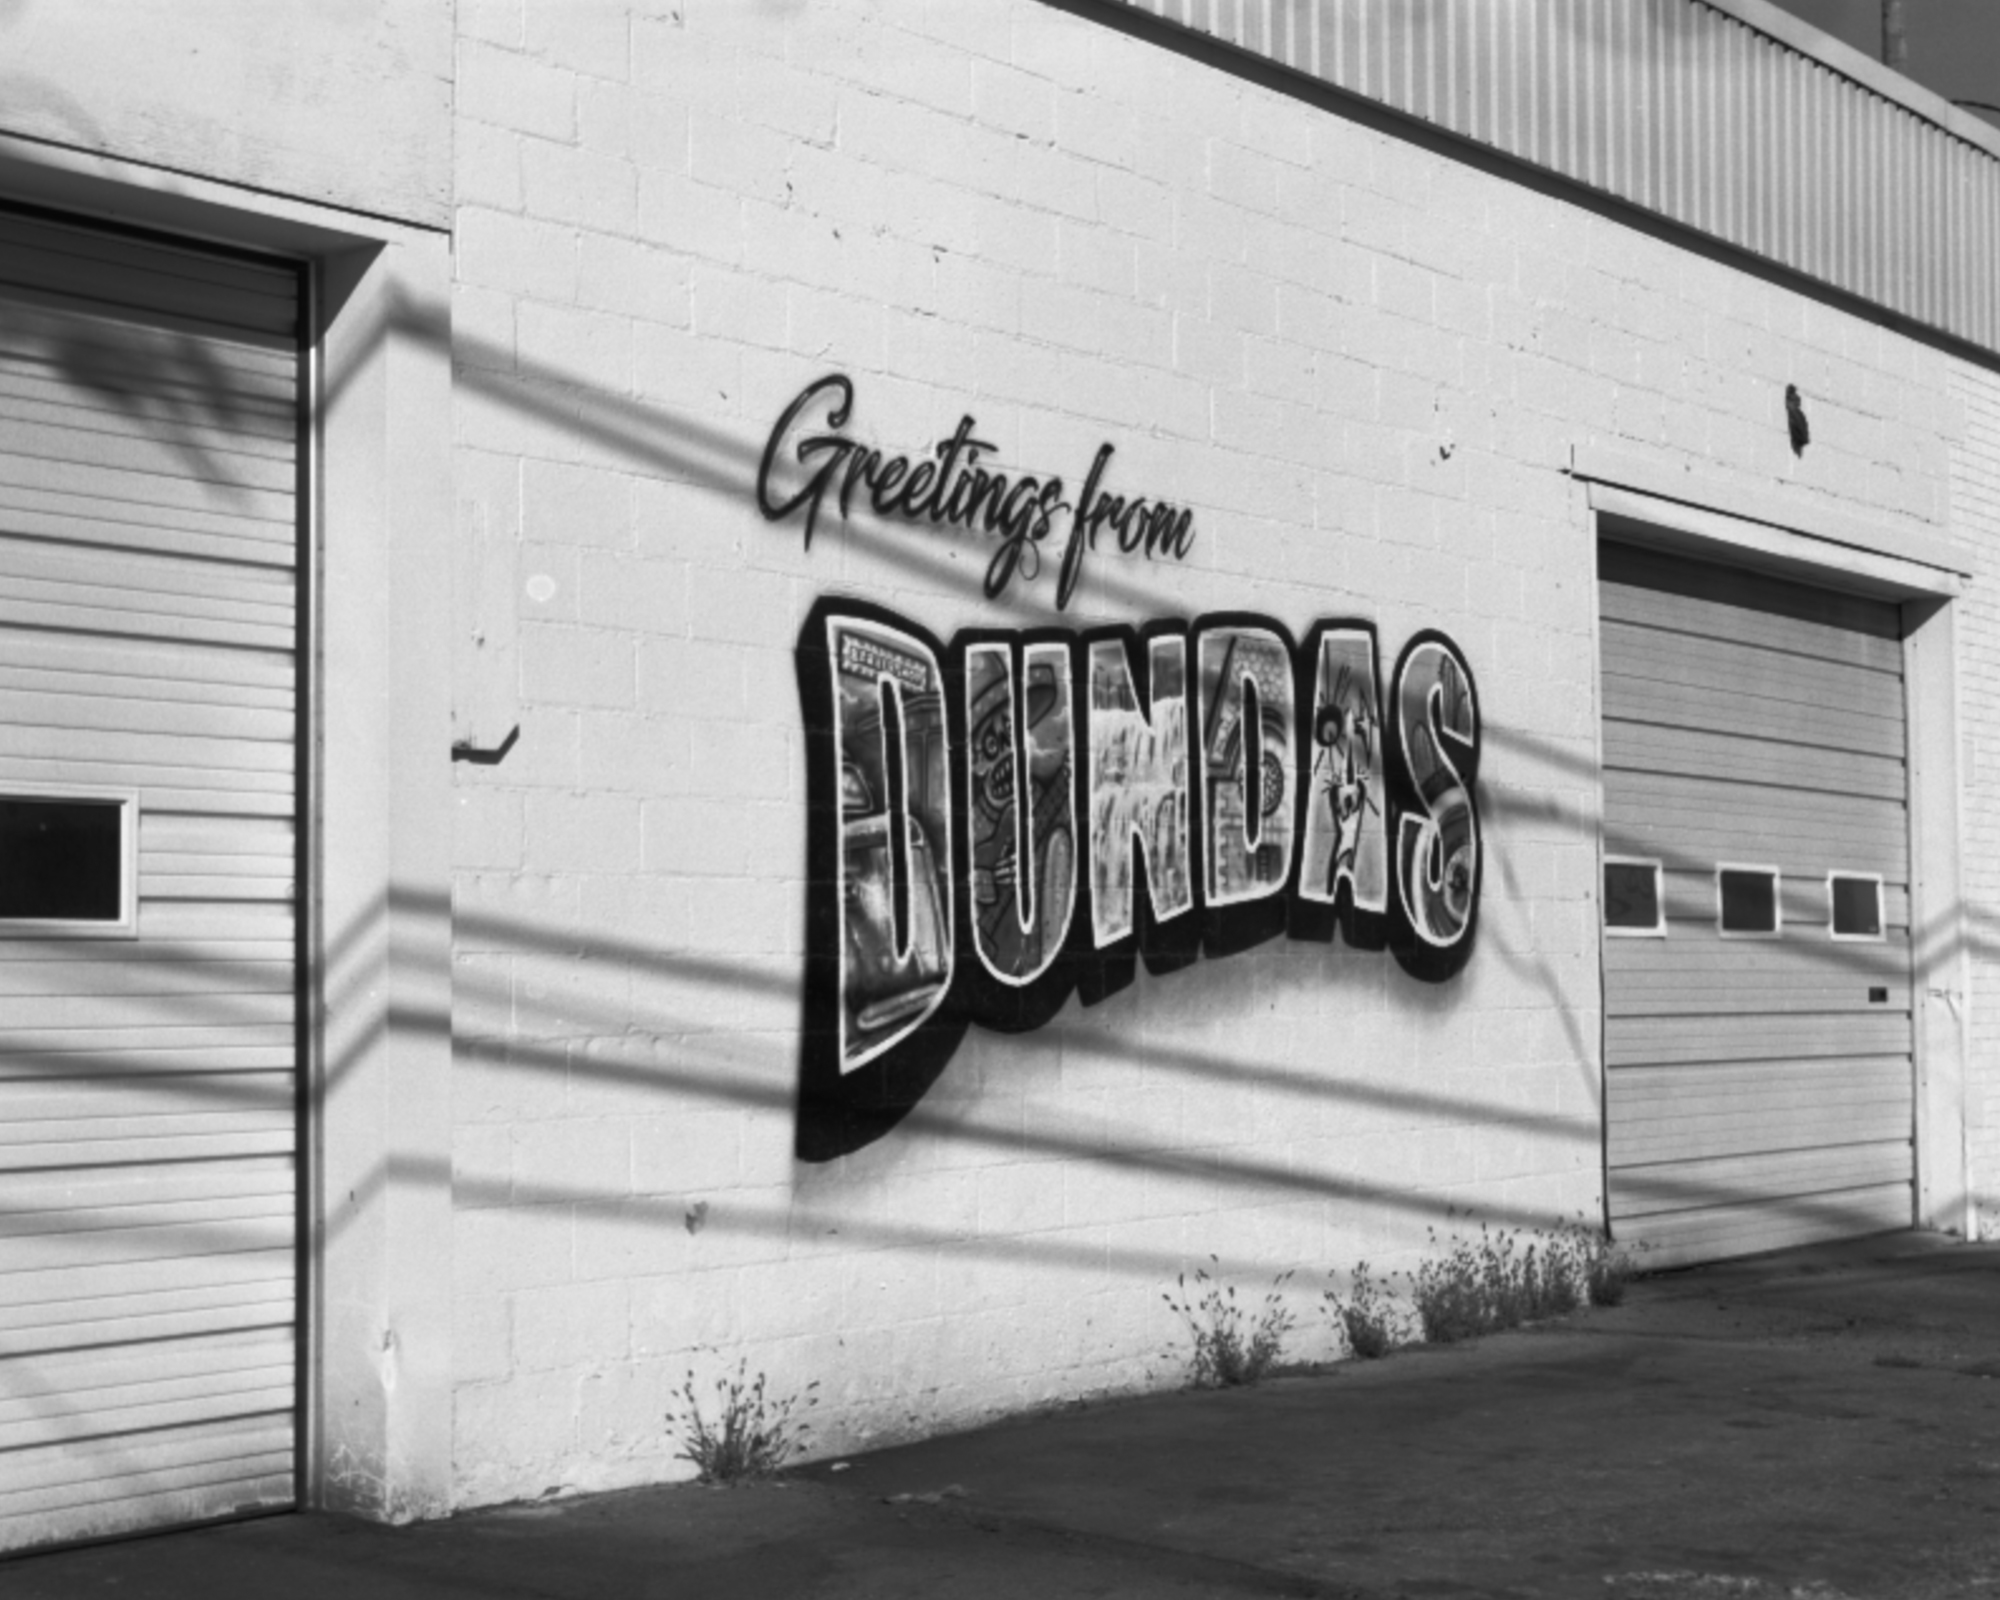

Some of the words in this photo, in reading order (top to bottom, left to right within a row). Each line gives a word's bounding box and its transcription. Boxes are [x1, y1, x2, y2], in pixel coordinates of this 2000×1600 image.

[757, 373, 1070, 599] Greetings
[1056, 442, 1196, 611] from
[818, 610, 1477, 1082] DUNDAS
